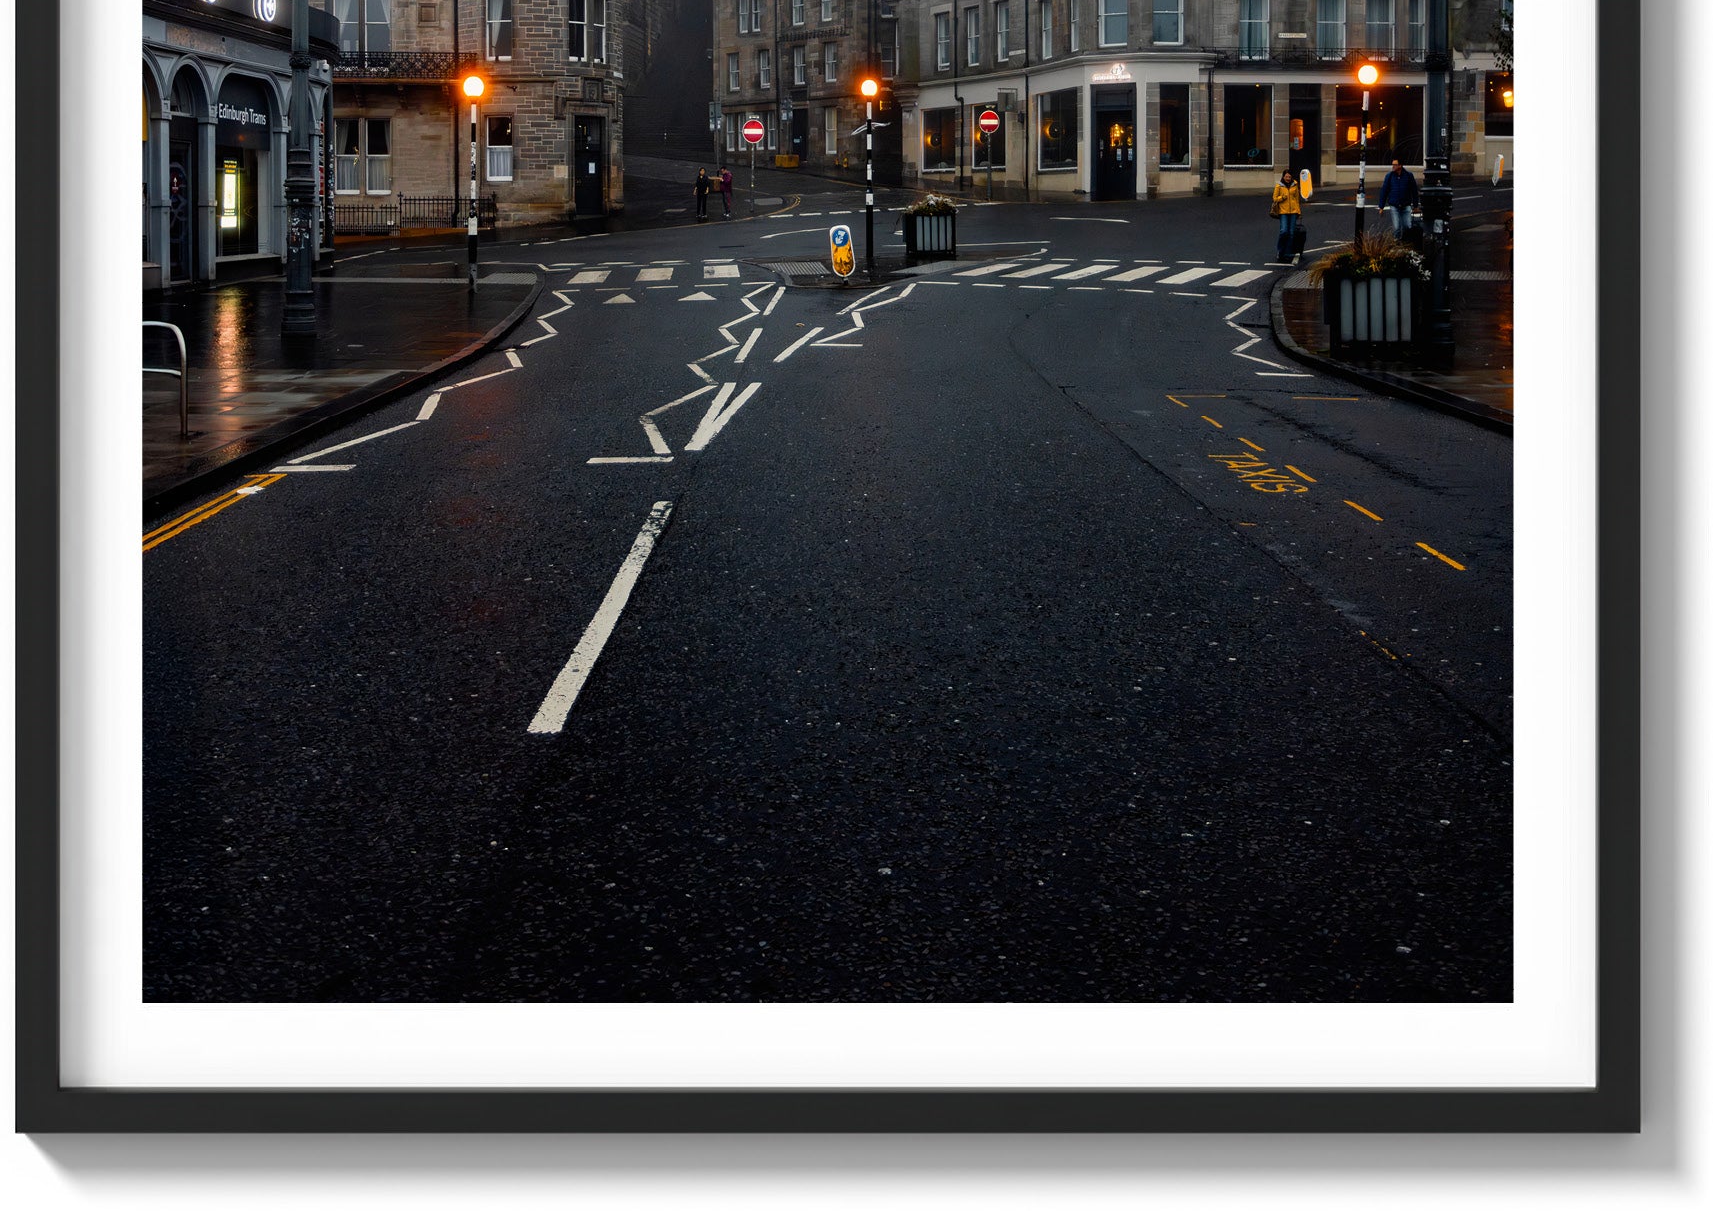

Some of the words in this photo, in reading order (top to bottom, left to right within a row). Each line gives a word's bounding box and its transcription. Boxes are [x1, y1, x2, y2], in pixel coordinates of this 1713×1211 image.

[218, 103, 249, 125] Edinburgh
[249, 108, 267, 125] Trams
[1208, 451, 1308, 493] TAXIS
